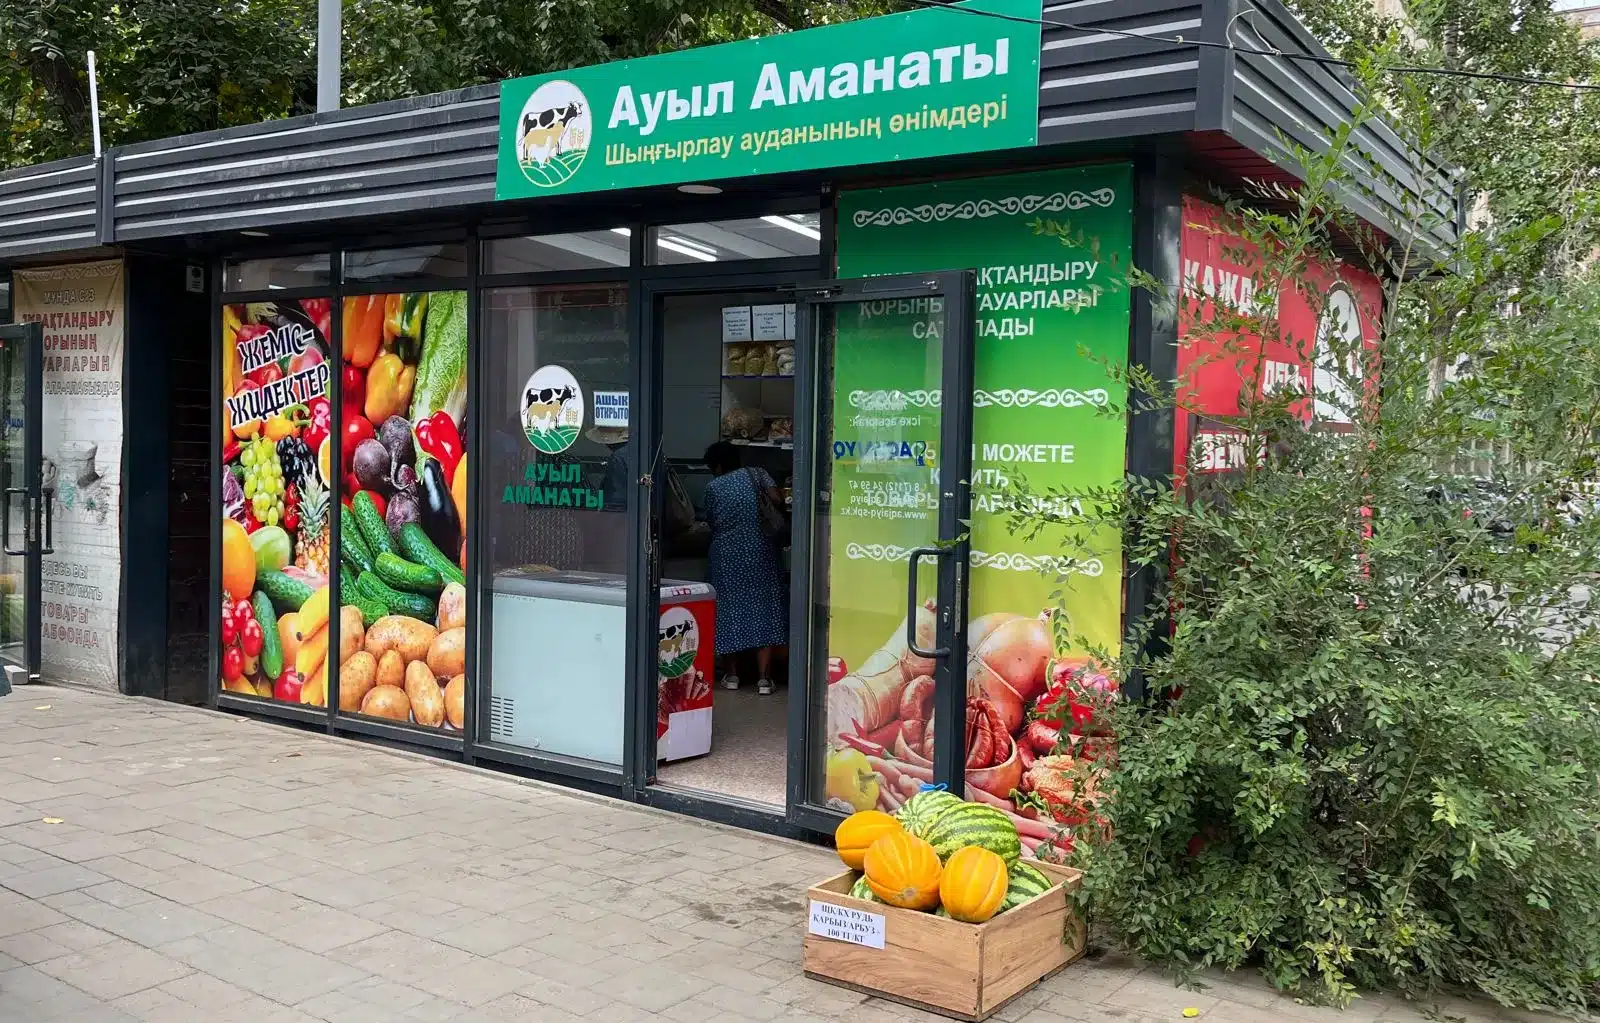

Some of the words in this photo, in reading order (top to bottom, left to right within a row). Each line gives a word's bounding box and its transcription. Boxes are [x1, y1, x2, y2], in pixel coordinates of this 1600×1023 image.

[607, 78, 735, 136] Ауыл
[749, 36, 1010, 111] Аманаты
[604, 136, 735, 167] Шыңғырлау
[740, 114, 883, 153] ауданының
[888, 92, 1009, 134] өнімдері
[43, 333, 97, 352] ОРЫНЫҢ
[236, 323, 316, 374] ЖЕМІС-
[43, 355, 110, 372] АРЛАРЫН
[227, 361, 331, 429] ЖИДЕКТЕР
[595, 407, 629, 420] ОТКРЫТО
[982, 443, 1075, 464] МОЖЕТЕ
[525, 463, 581, 483] АУЫЛ
[502, 485, 605, 510] АМАНАТЫ
[41, 623, 99, 648] АБФОНДА
[851, 911, 874, 924] РУДЬ
[827, 928, 840, 938] 100
